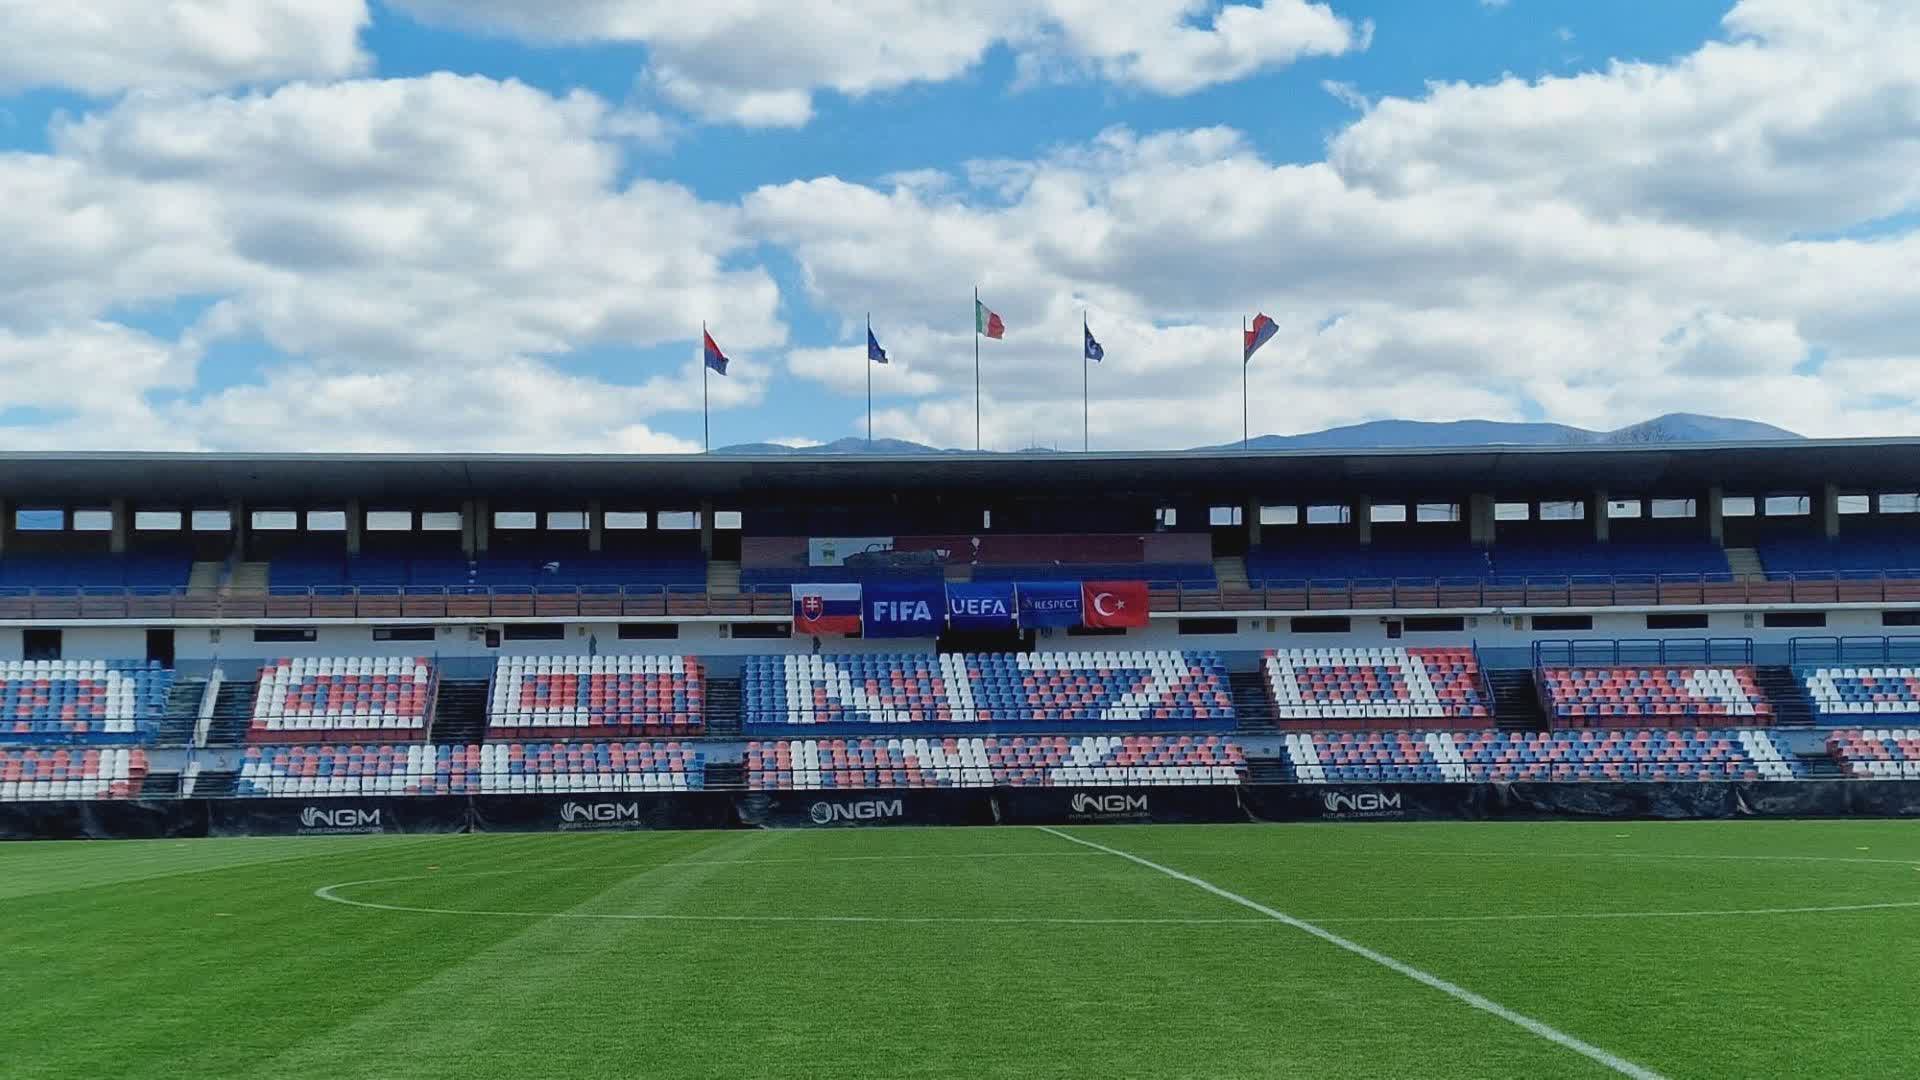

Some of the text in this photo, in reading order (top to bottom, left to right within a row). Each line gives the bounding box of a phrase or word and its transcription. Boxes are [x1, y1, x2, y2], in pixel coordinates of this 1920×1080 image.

[873, 600, 932, 621] FIFA
[951, 599, 1006, 615] UEFA
[1035, 599, 1079, 610] RESPECT
[561, 802, 638, 821] NGM
[1072, 793, 1148, 812] NGM
[1325, 793, 1401, 811] NGM
[301, 807, 380, 826] NGM
